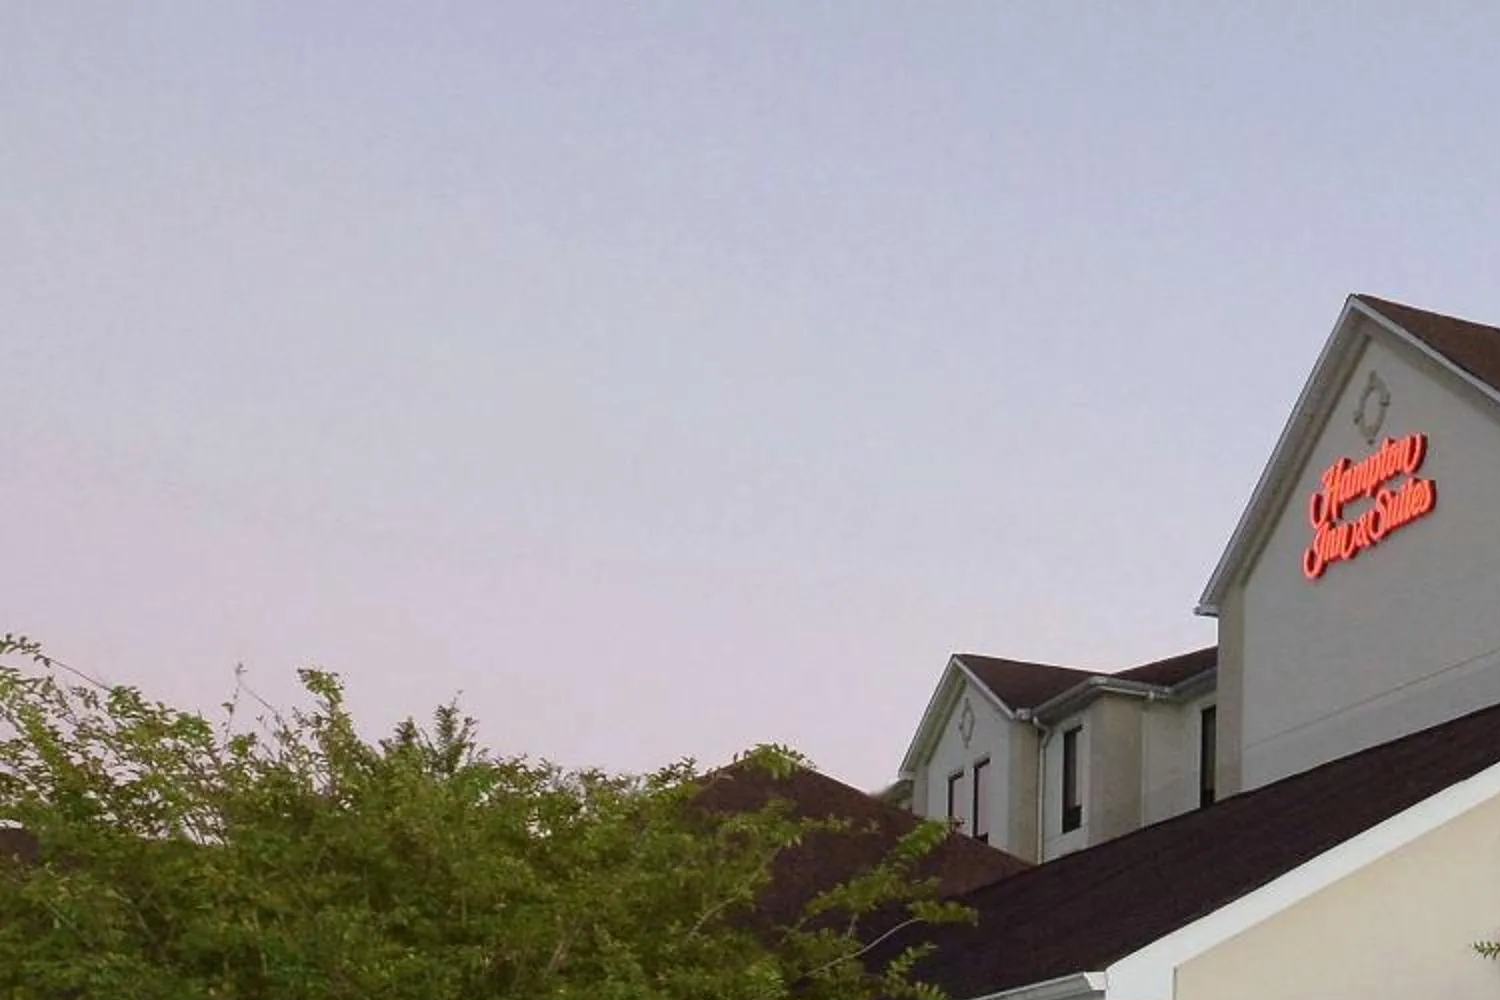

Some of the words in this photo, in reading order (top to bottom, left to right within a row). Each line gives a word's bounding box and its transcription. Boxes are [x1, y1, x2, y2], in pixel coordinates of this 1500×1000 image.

[1303, 520, 1358, 579] Inn
[1369, 476, 1437, 543] Suites
[1310, 431, 1428, 530] Hampton
